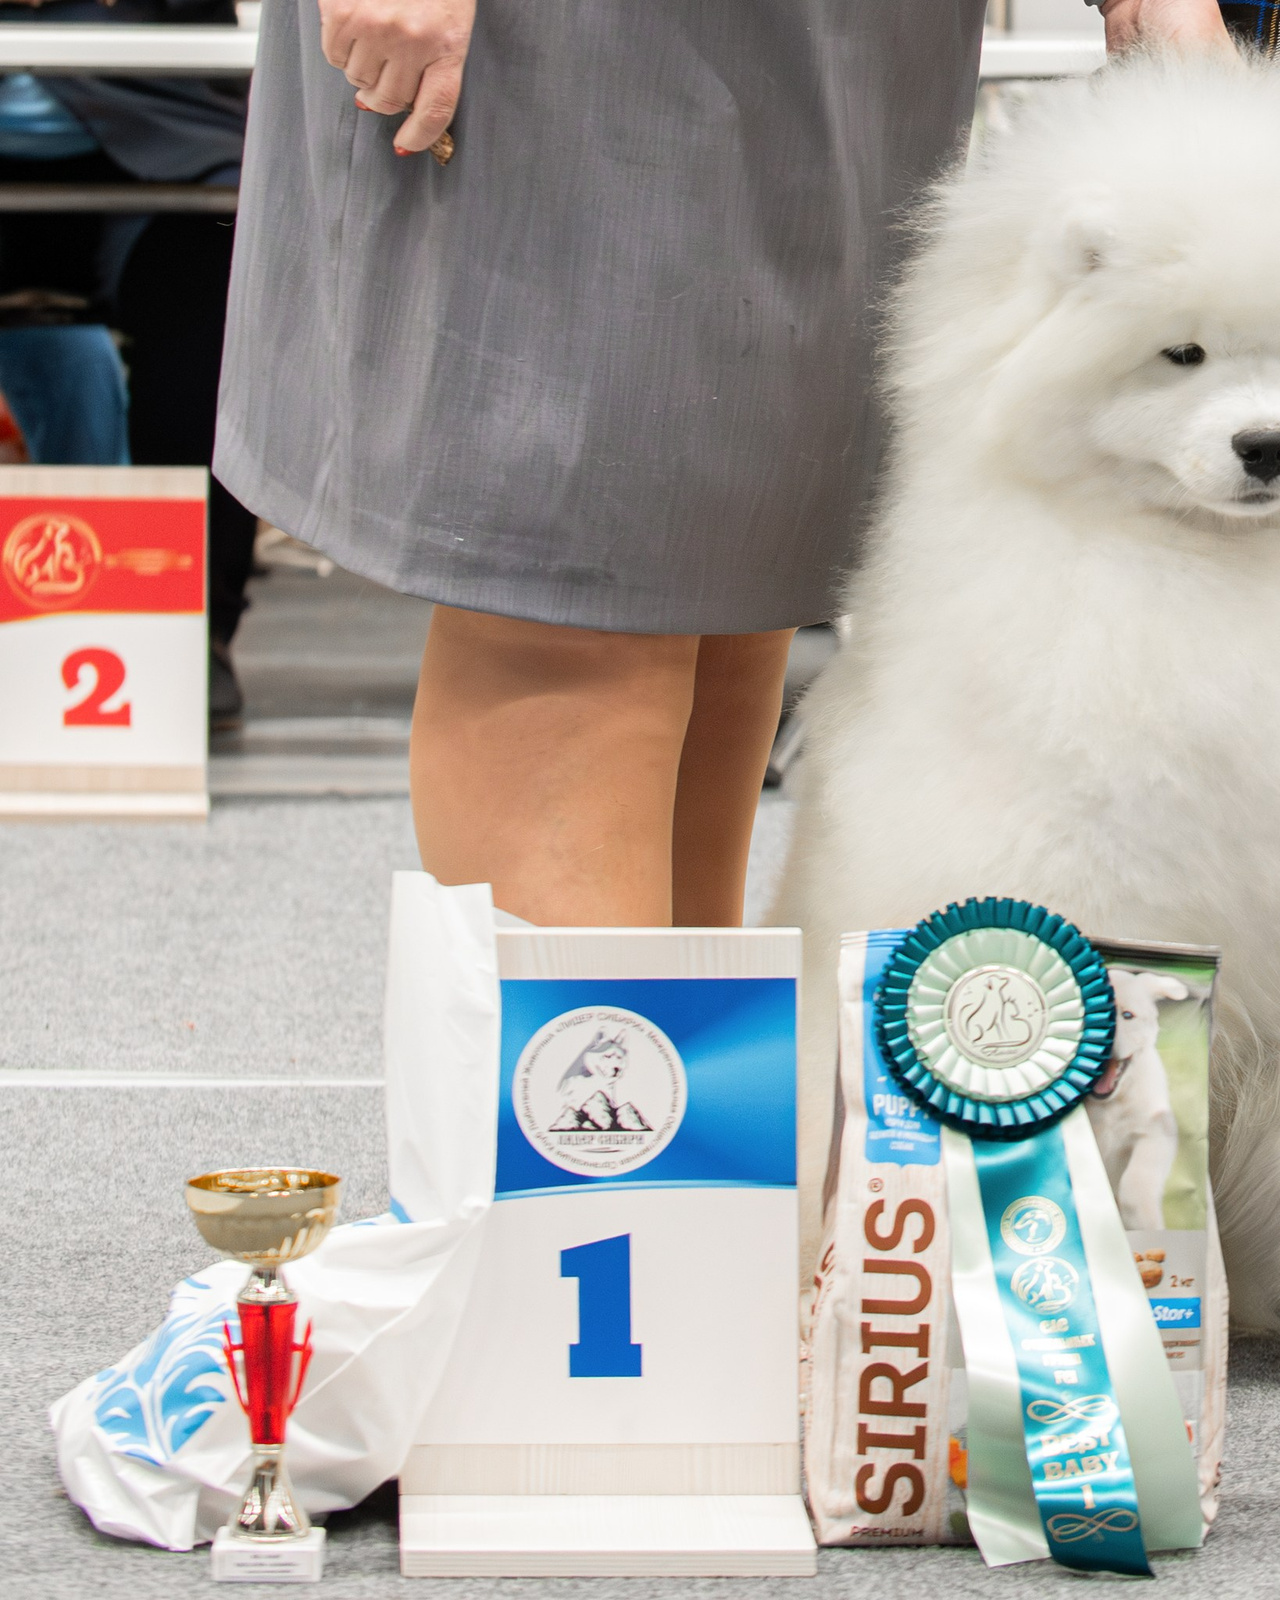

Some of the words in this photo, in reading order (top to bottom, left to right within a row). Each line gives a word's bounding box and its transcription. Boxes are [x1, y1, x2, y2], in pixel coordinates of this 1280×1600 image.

[60, 646, 131, 728] 2
[559, 1232, 643, 1378] 1
[1042, 1450, 1119, 1481] BABY
[850, 1525, 924, 1538] PREMIUM
